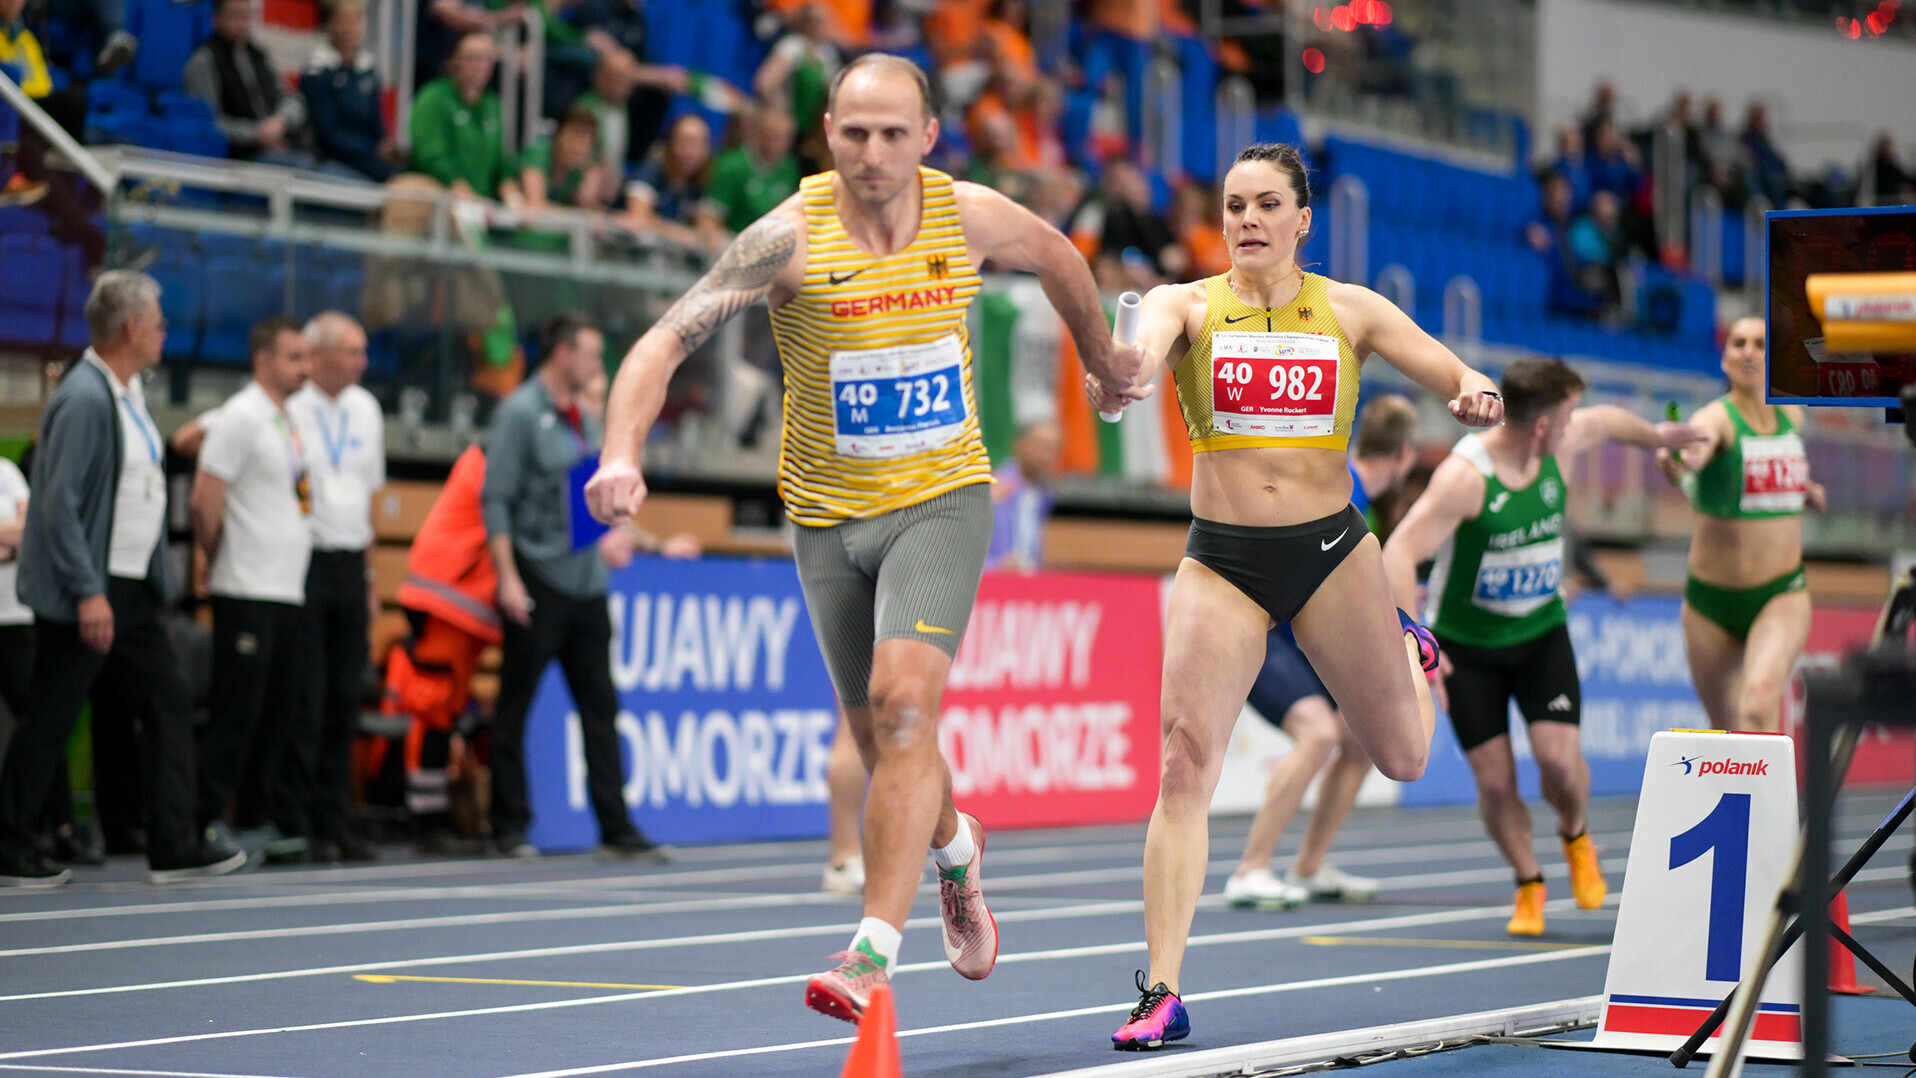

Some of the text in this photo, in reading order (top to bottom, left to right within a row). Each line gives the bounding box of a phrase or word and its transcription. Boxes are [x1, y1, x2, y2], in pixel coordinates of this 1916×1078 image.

[831, 287, 957, 317] GERMANY
[839, 382, 878, 406] 40
[894, 374, 951, 419] 732
[1218, 362, 1323, 401] 40 982
[1227, 387, 1244, 401] W
[851, 407, 869, 424] M
[1488, 512, 1563, 549] IRELAND
[608, 591, 799, 692] UJAWY
[937, 699, 1137, 798] OMORZE
[1698, 758, 1769, 777] polanik
[1669, 793, 1751, 982] 1
